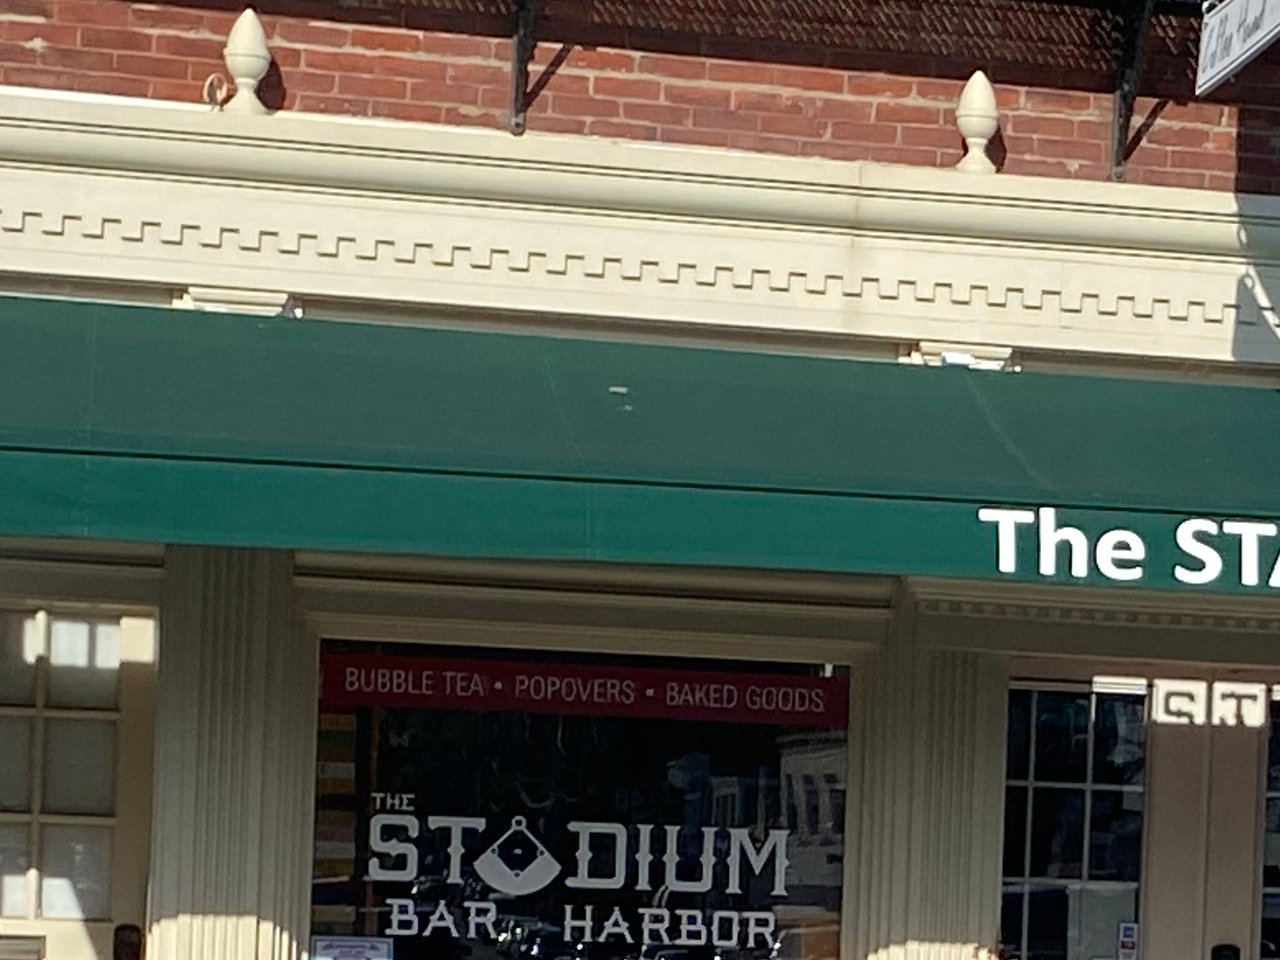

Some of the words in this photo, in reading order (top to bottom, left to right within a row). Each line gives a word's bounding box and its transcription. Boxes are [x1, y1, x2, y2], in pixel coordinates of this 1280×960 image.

[978, 507, 1146, 581] The
[345, 667, 434, 696] BUBBLE
[442, 671, 484, 698] TEA
[515, 675, 635, 705] POPOVERS
[666, 681, 738, 710] BAKED
[746, 686, 825, 714] GOODS
[371, 792, 415, 811] THE
[385, 898, 500, 939] BAR
[563, 905, 776, 948] HARBOR
